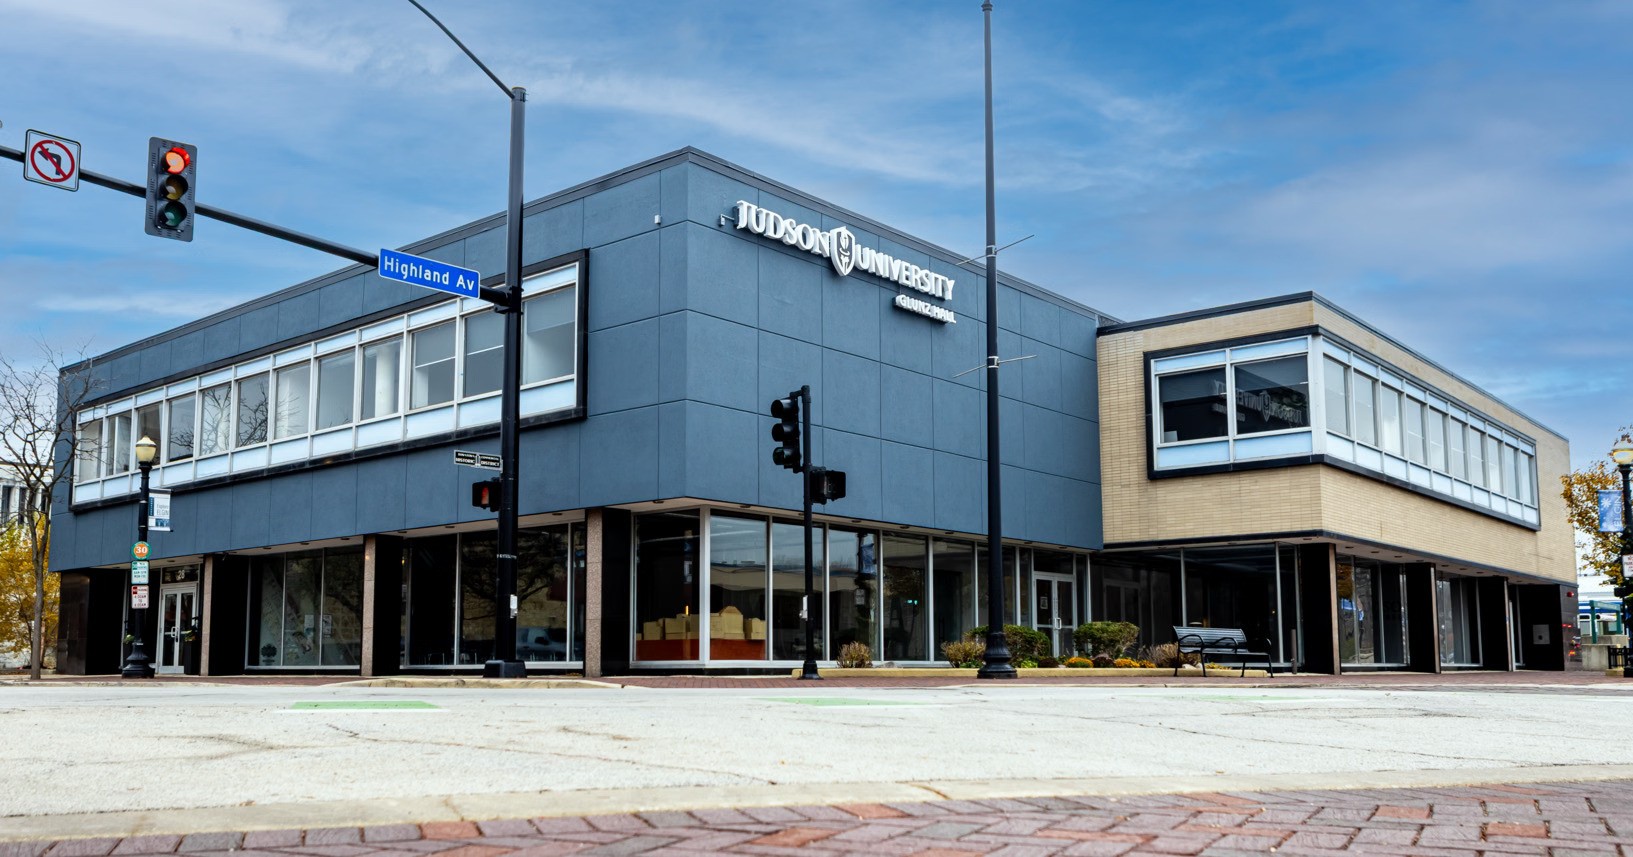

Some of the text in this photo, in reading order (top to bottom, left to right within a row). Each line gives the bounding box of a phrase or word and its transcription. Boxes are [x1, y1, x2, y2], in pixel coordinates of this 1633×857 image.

[736, 200, 955, 301] JUDSON UNIVERSITY
[384, 256, 475, 291] Highland Av
[896, 294, 957, 324] GLUNZ HALL
[135, 546, 148, 554] 30
